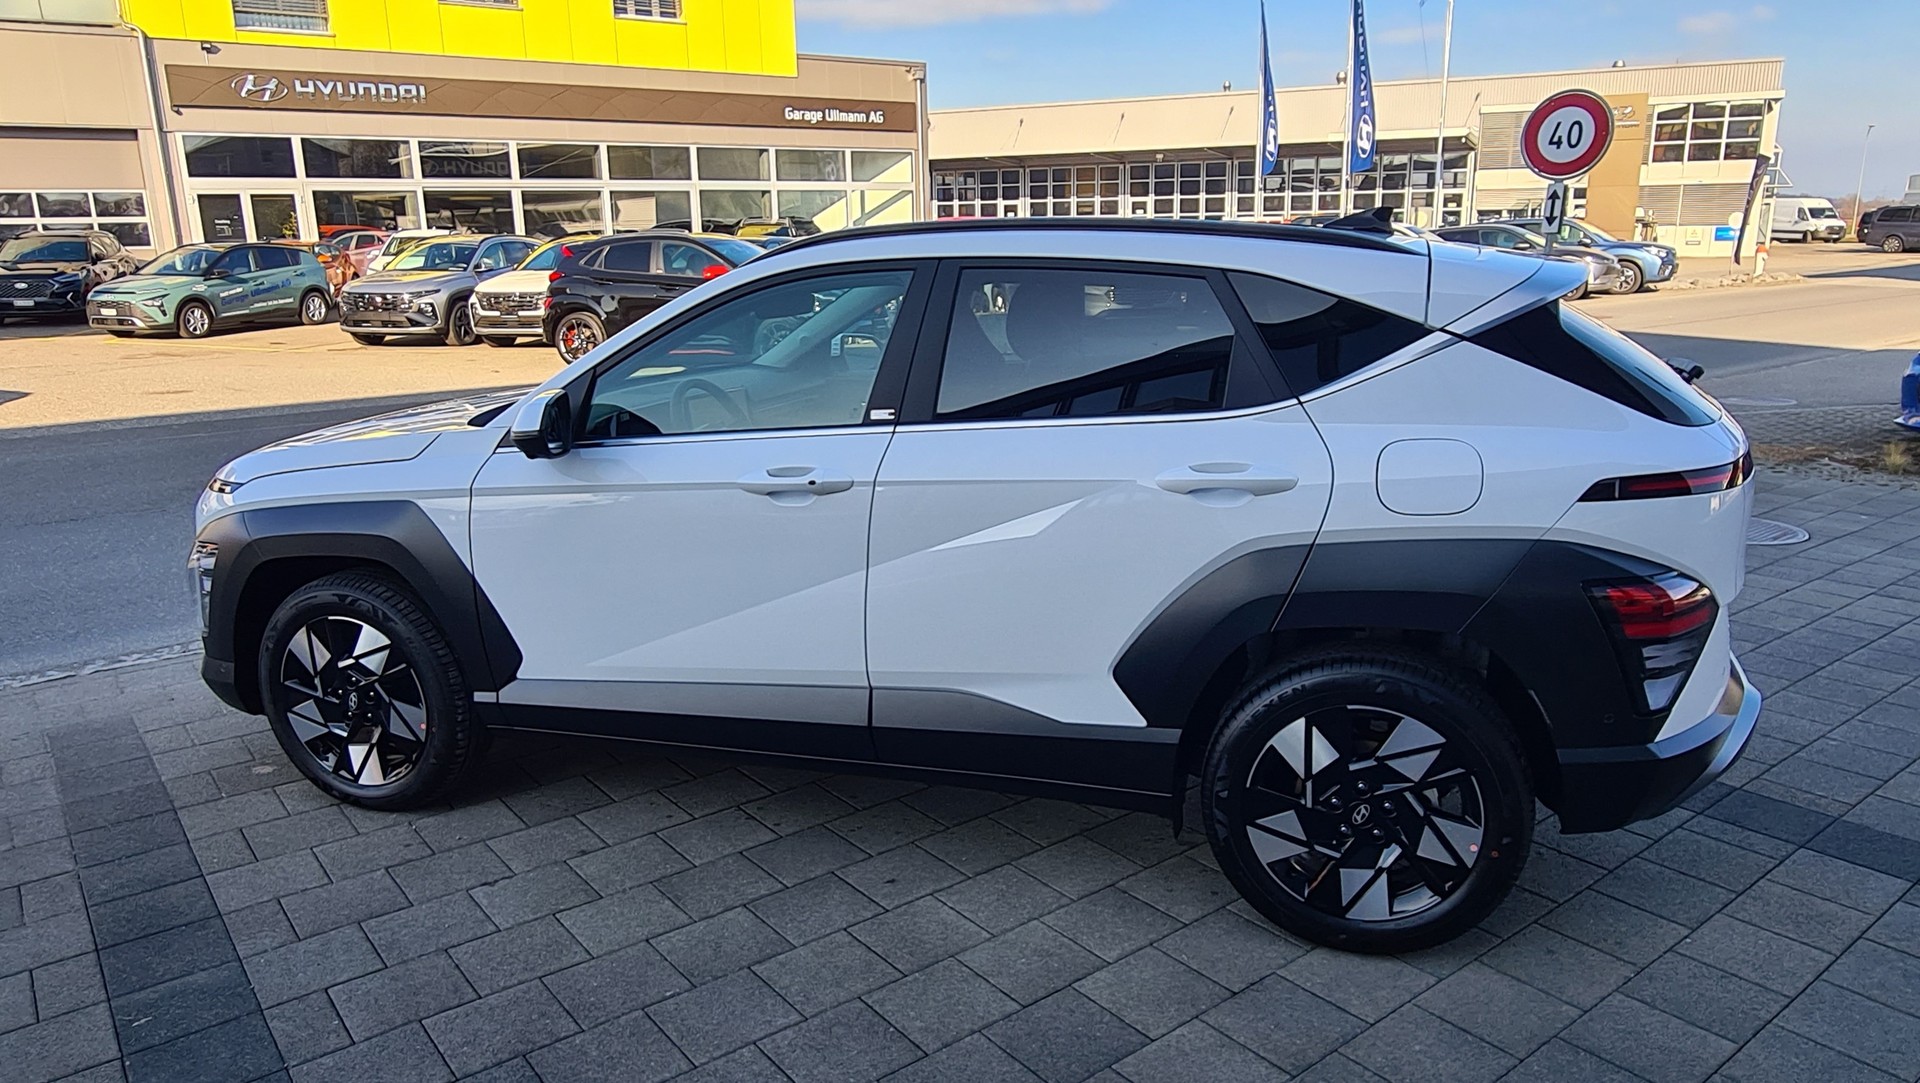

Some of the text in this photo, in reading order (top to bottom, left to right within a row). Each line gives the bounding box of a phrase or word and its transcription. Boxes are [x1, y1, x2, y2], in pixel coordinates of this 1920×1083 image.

[293, 78, 427, 104] HYUNDAI
[784, 106, 884, 124] Garage Ullmann AG
[1548, 119, 1584, 150] 40
